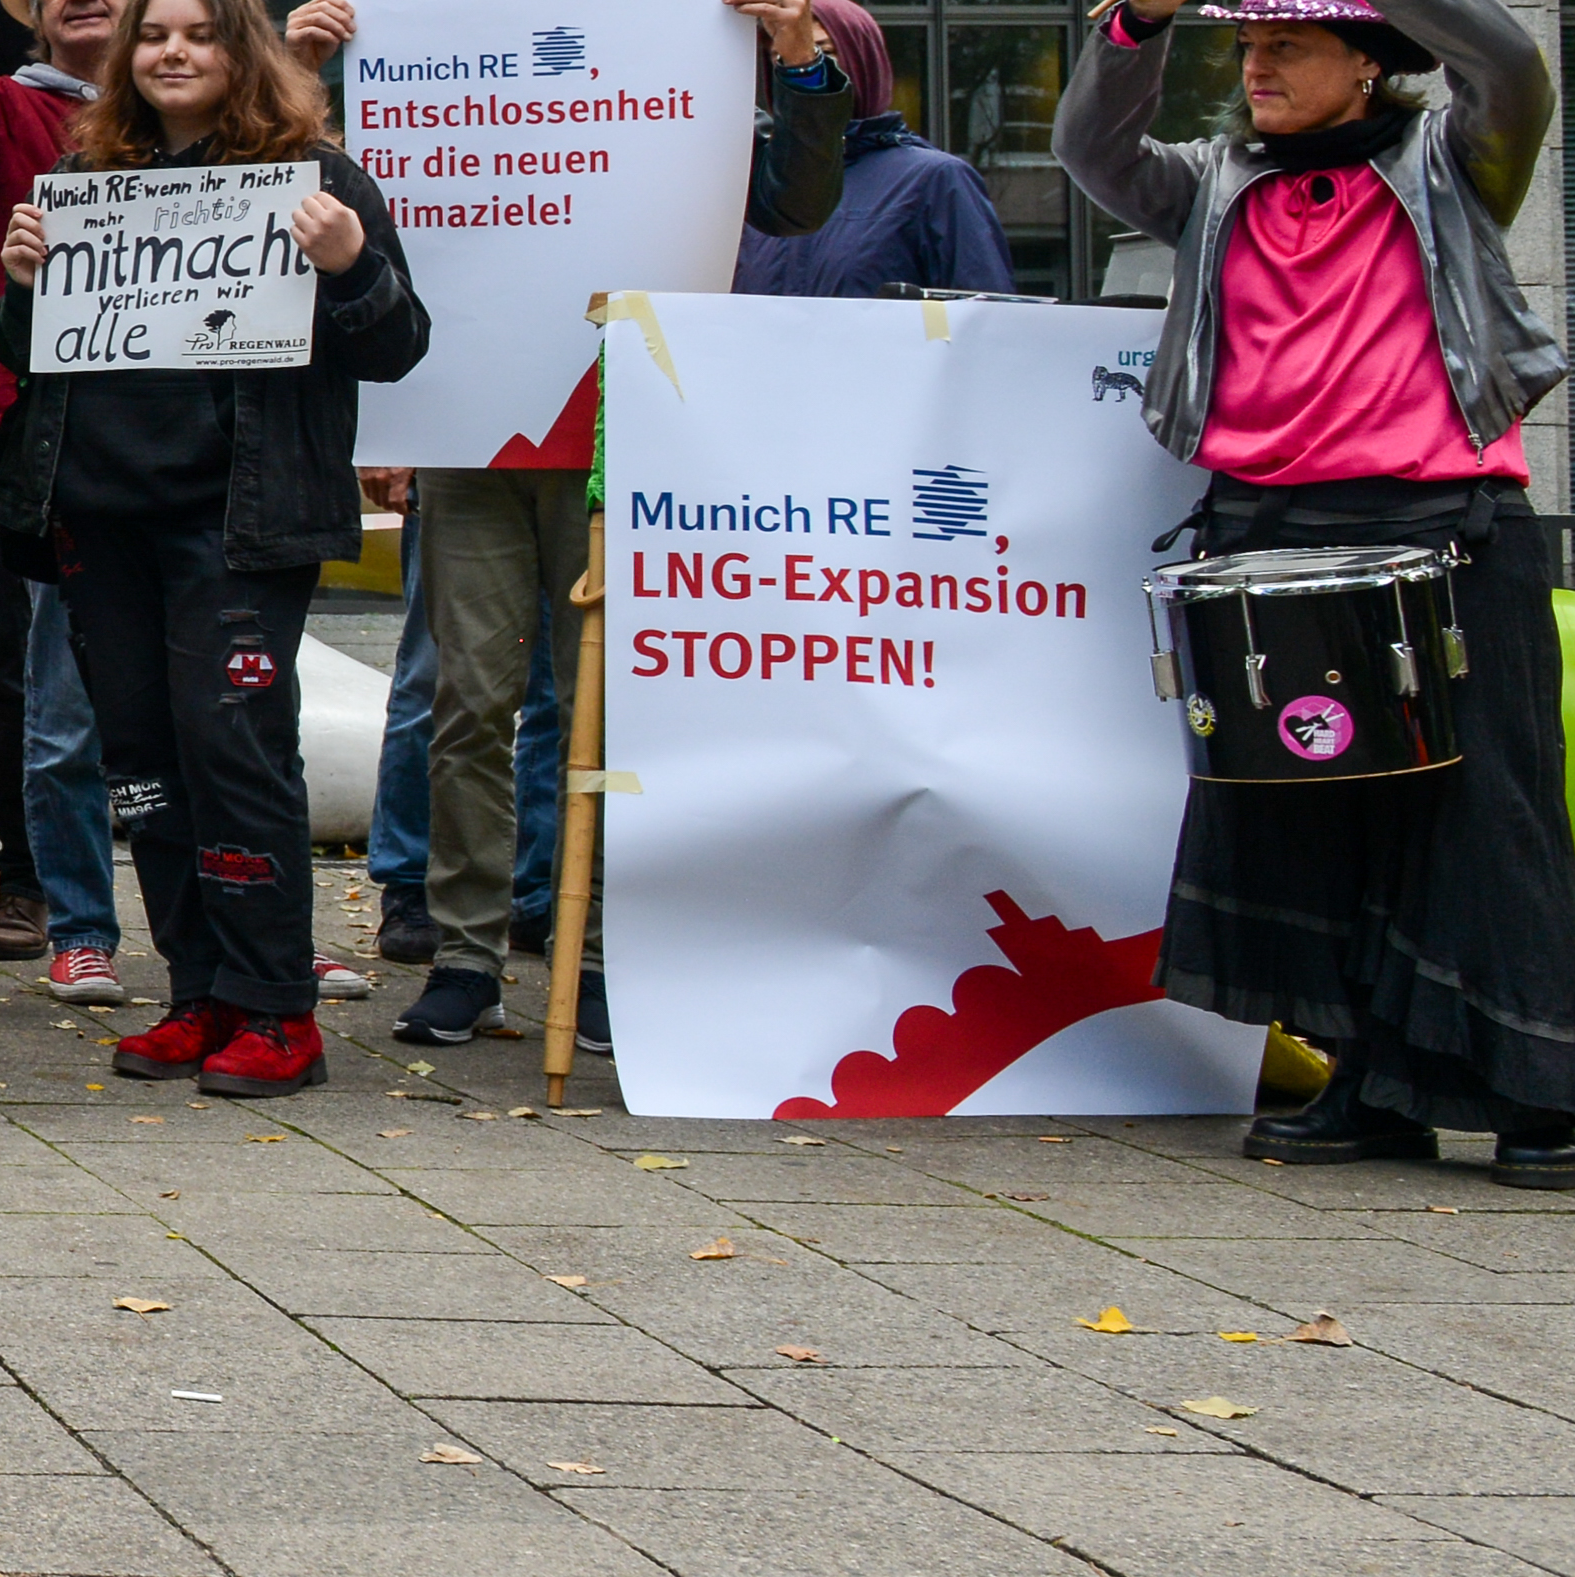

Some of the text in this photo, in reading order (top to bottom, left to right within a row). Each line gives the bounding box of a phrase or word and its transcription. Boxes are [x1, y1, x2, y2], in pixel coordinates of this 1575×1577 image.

[358, 54, 470, 83] Munich
[479, 52, 519, 79] RE
[360, 87, 695, 130] Entschlossenheit
[360, 145, 610, 180] für die neuen
[37, 175, 99, 212] Munich
[144, 181, 192, 198] wenn
[199, 170, 226, 194] ihr
[239, 165, 296, 190] nicht
[83, 198, 252, 232] mehr richtig
[388, 194, 572, 229] limaziele!
[98, 280, 254, 315] verlieren wir
[54, 312, 151, 364] alle
[229, 338, 307, 350] REGENWALD
[195, 356, 295, 367] www.pro-regenwald.de
[630, 491, 812, 534] Munich
[827, 496, 892, 537] RE
[632, 551, 1088, 620] LNG-Expansion
[631, 629, 936, 689] STOPPEN!
